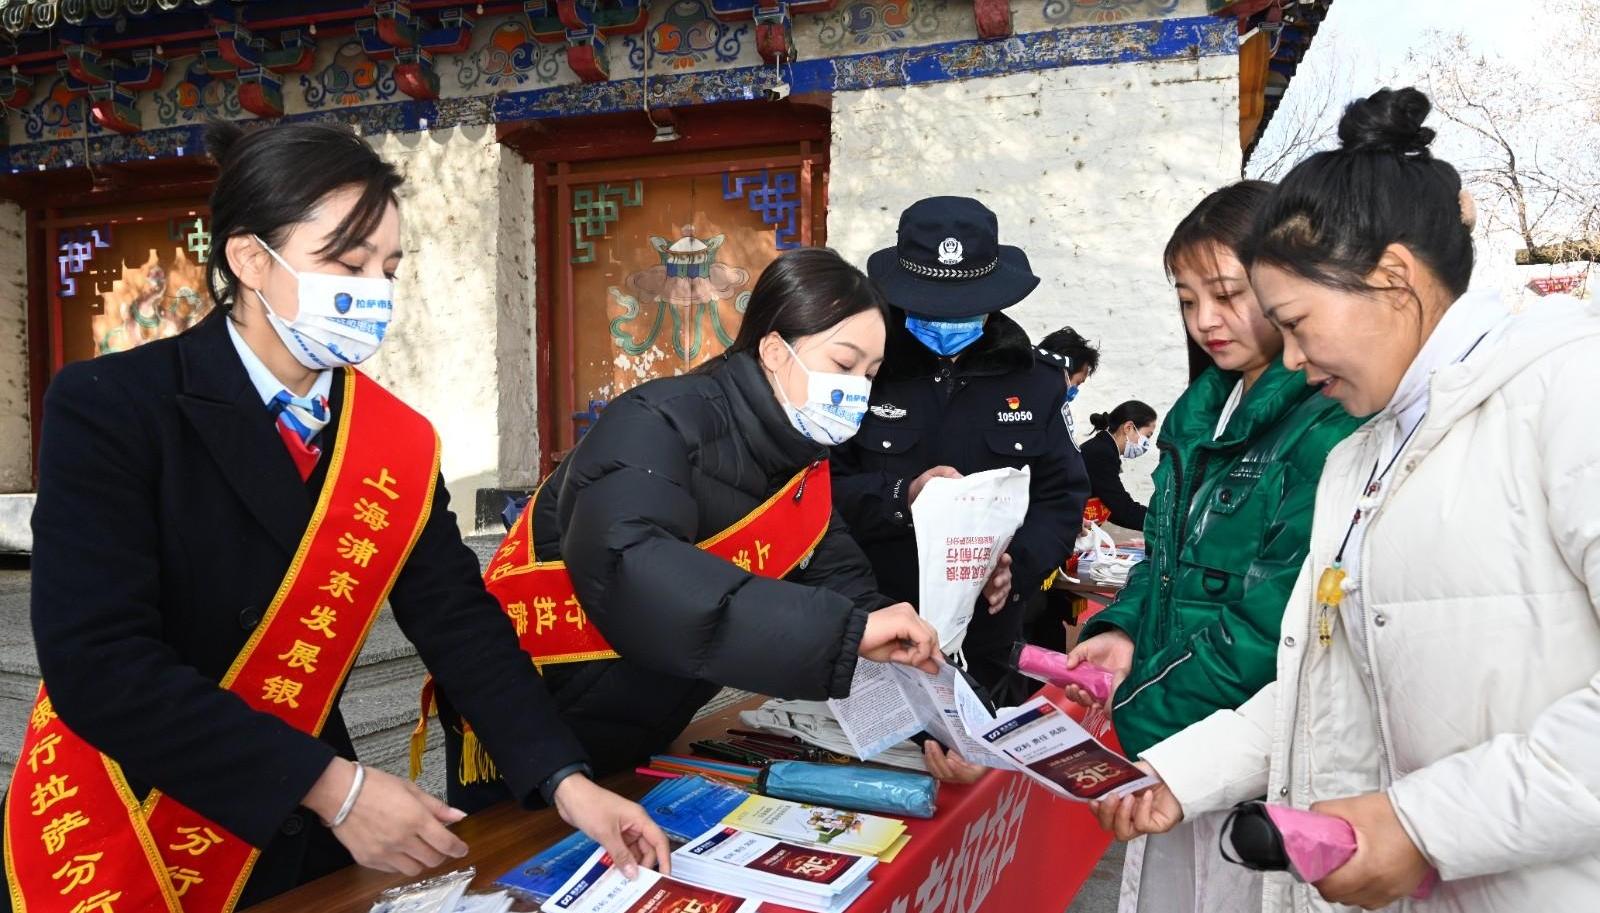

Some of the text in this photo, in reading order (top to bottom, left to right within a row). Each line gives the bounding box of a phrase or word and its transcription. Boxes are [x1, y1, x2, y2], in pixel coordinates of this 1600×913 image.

[997, 411, 1033, 422] 105050
[261, 467, 401, 709] 上海浦东发展银
[26, 695, 123, 913] 银行拉萨分行
[168, 825, 225, 897] 分行
[884, 773, 1034, 913] 者权益日
